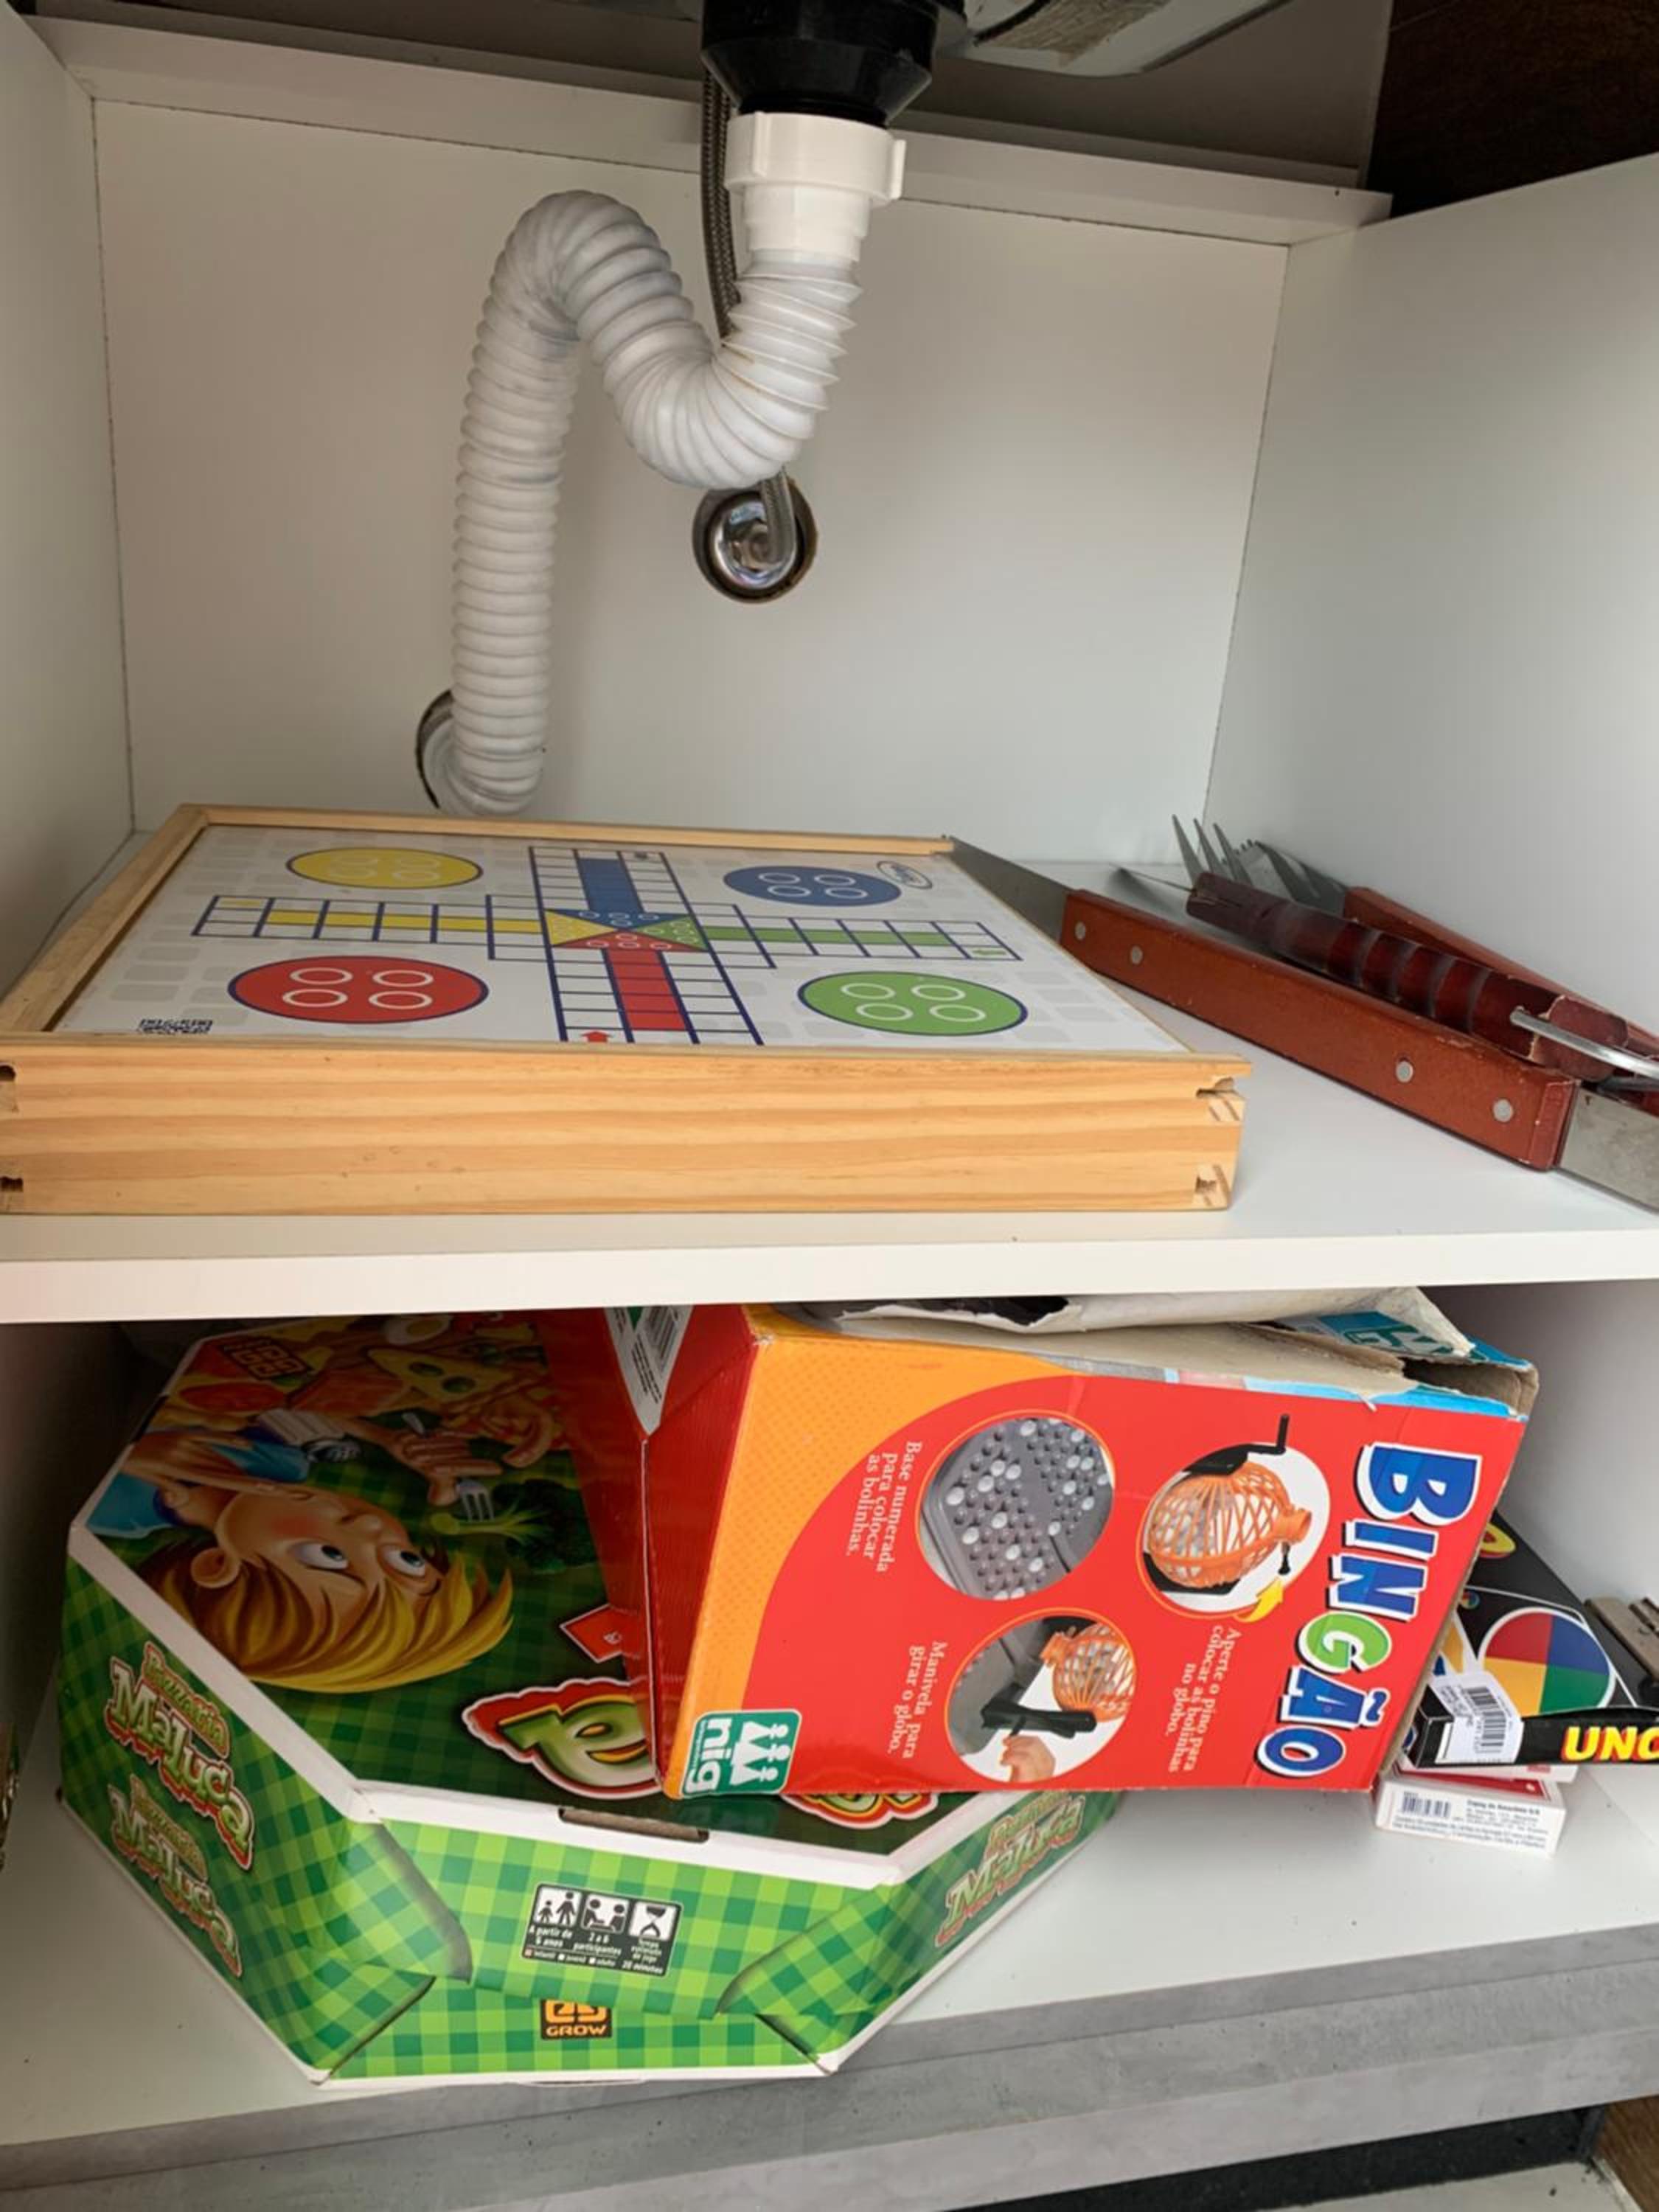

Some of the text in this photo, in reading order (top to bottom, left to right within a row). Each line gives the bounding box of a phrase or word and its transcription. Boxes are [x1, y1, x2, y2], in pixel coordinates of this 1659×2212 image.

[846, 1454, 880, 1557] as bolinhas.
[863, 1453, 898, 1559] para colocar
[877, 1441, 922, 1572] Base numerada
[1256, 1441, 1482, 1777] BINGÃO
[887, 1645, 927, 1754] girar o globo.
[902, 1641, 947, 1759] Manivela para
[1165, 1663, 1197, 1736] no globo.
[1168, 1626, 1223, 1773] colocar as bolinhas
[1183, 1627, 1242, 1771] Aperte o pino para
[685, 1717, 732, 1793] nig
[562, 1928, 573, 1939] de
[546, 2025, 607, 2037] GROW
